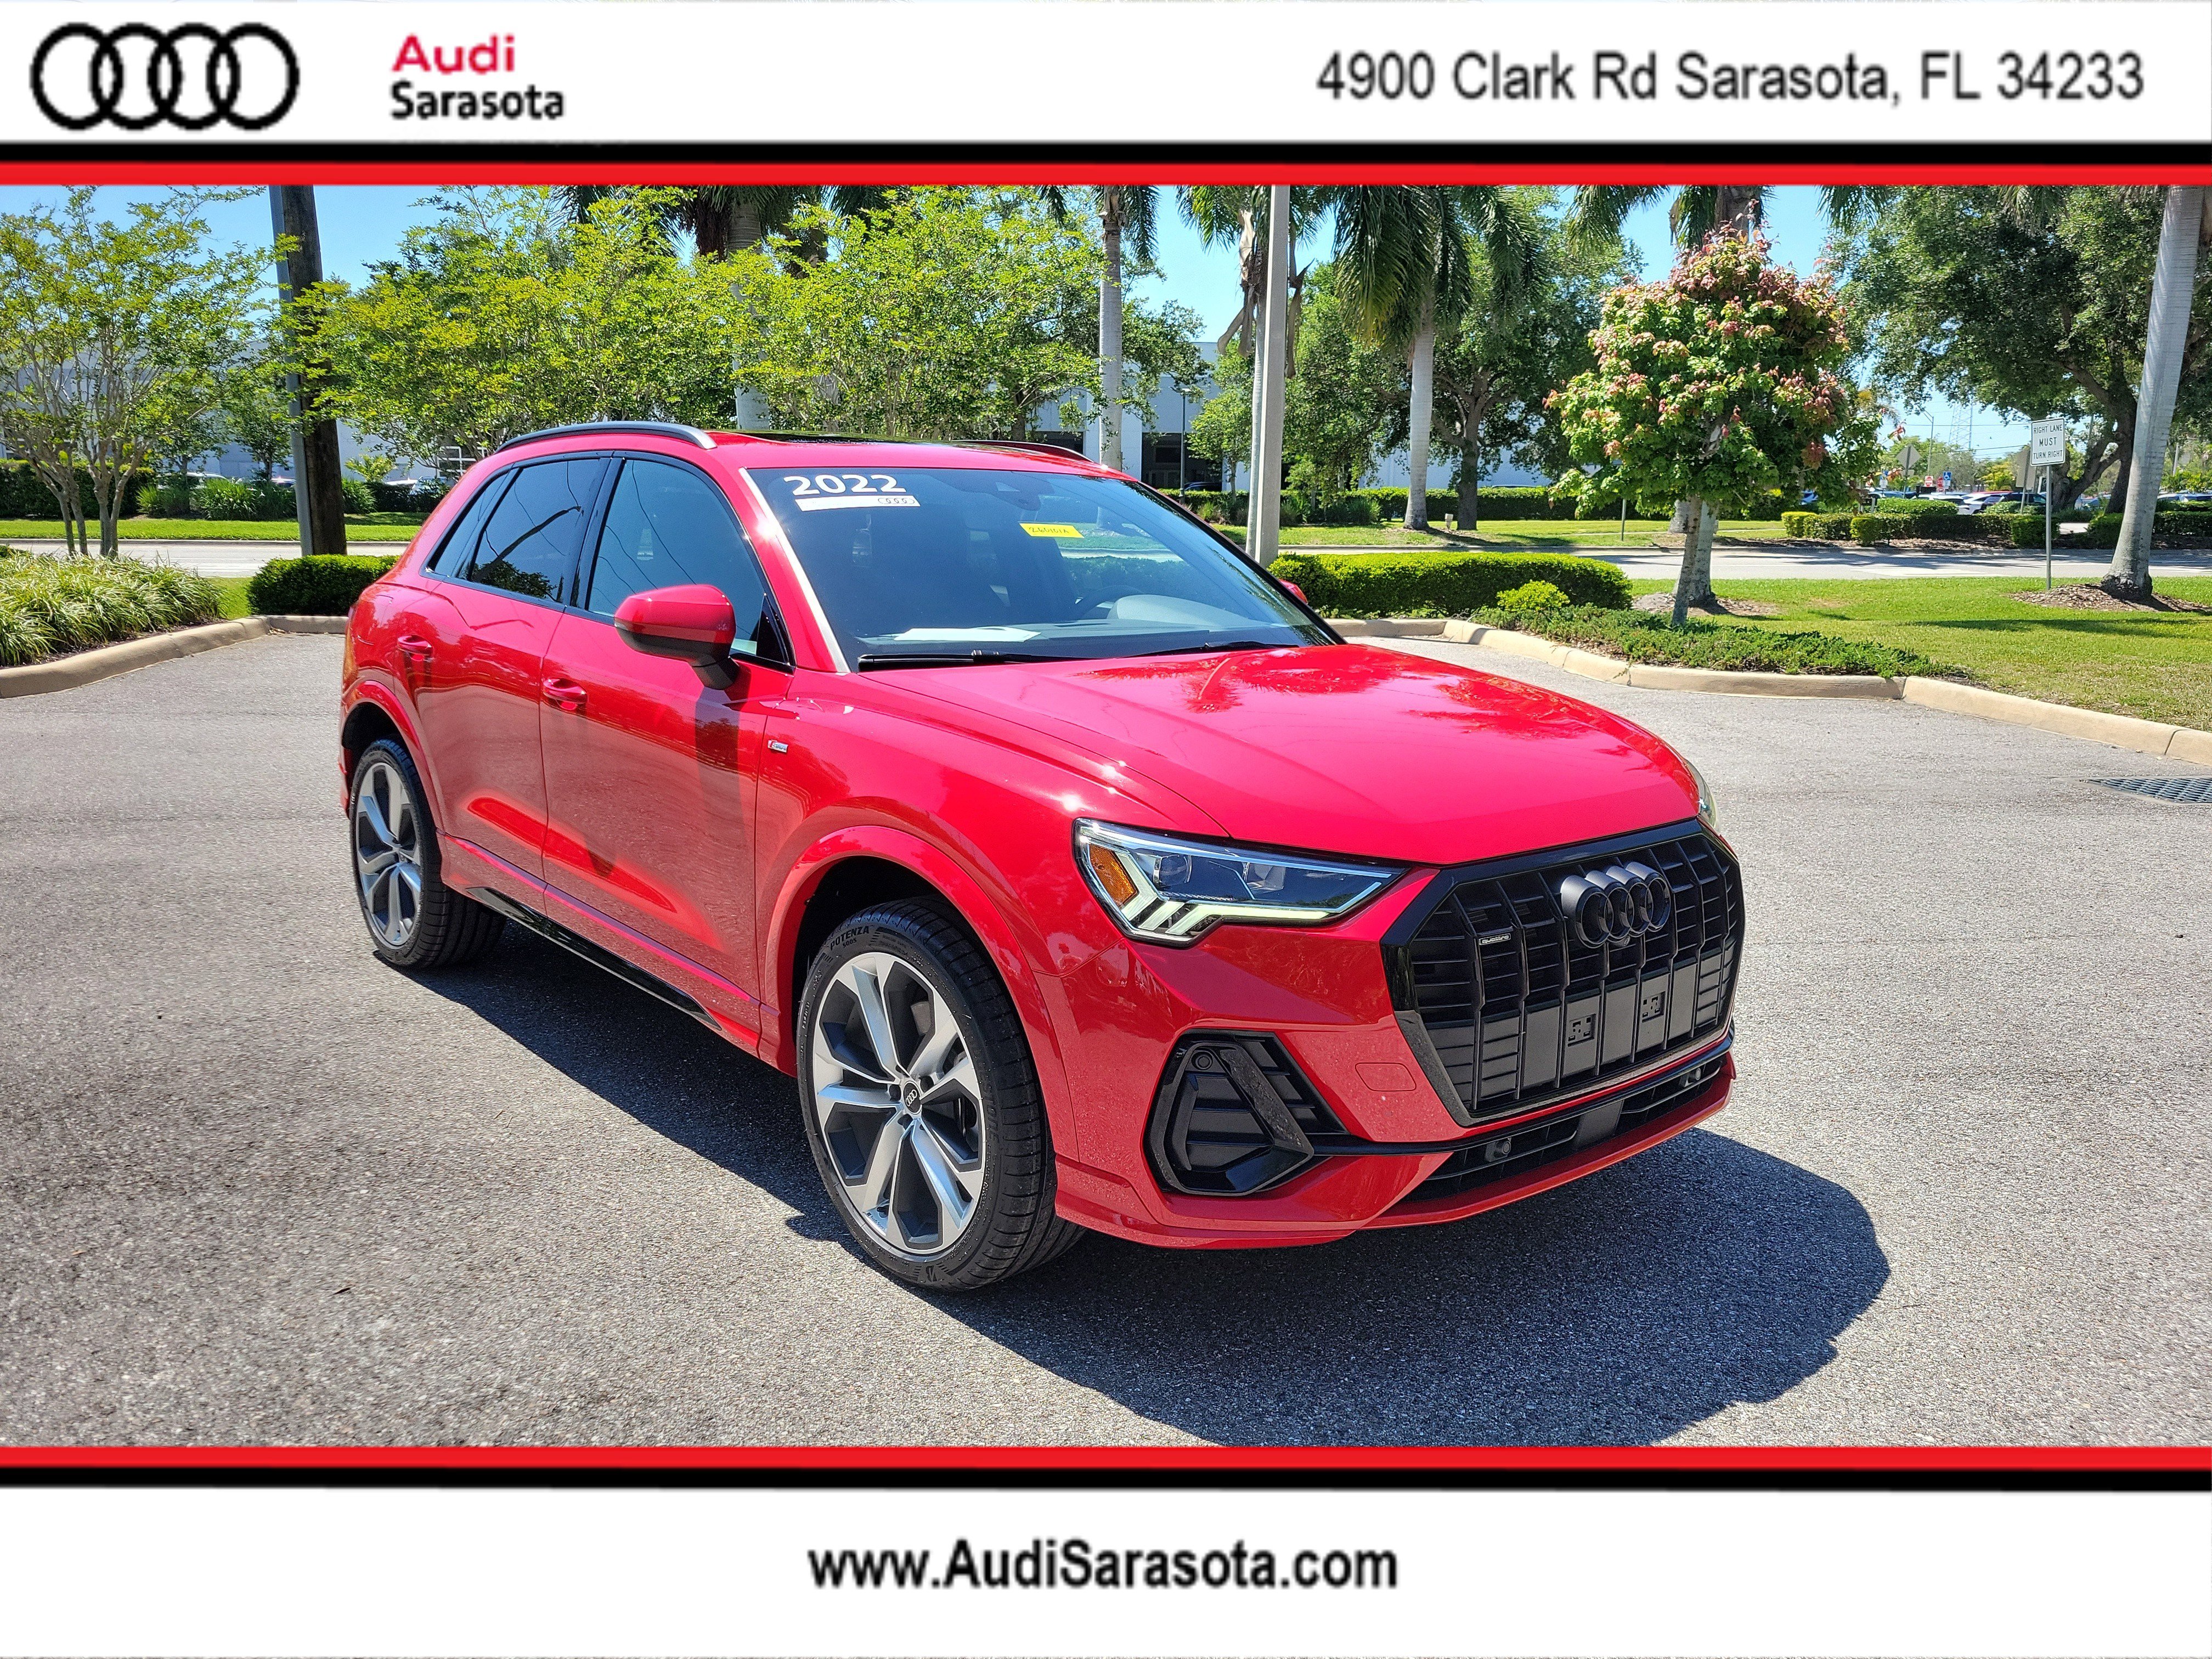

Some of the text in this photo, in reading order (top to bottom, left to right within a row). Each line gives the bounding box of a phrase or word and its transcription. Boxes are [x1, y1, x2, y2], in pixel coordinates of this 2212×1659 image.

[2033, 424, 2063, 434] RIGHT LANE
[2039, 437, 2057, 447] MUST
[2048, 450, 2063, 458] RIGHT
[783, 474, 907, 496] 2022
[830, 926, 870, 951] POTENZA
